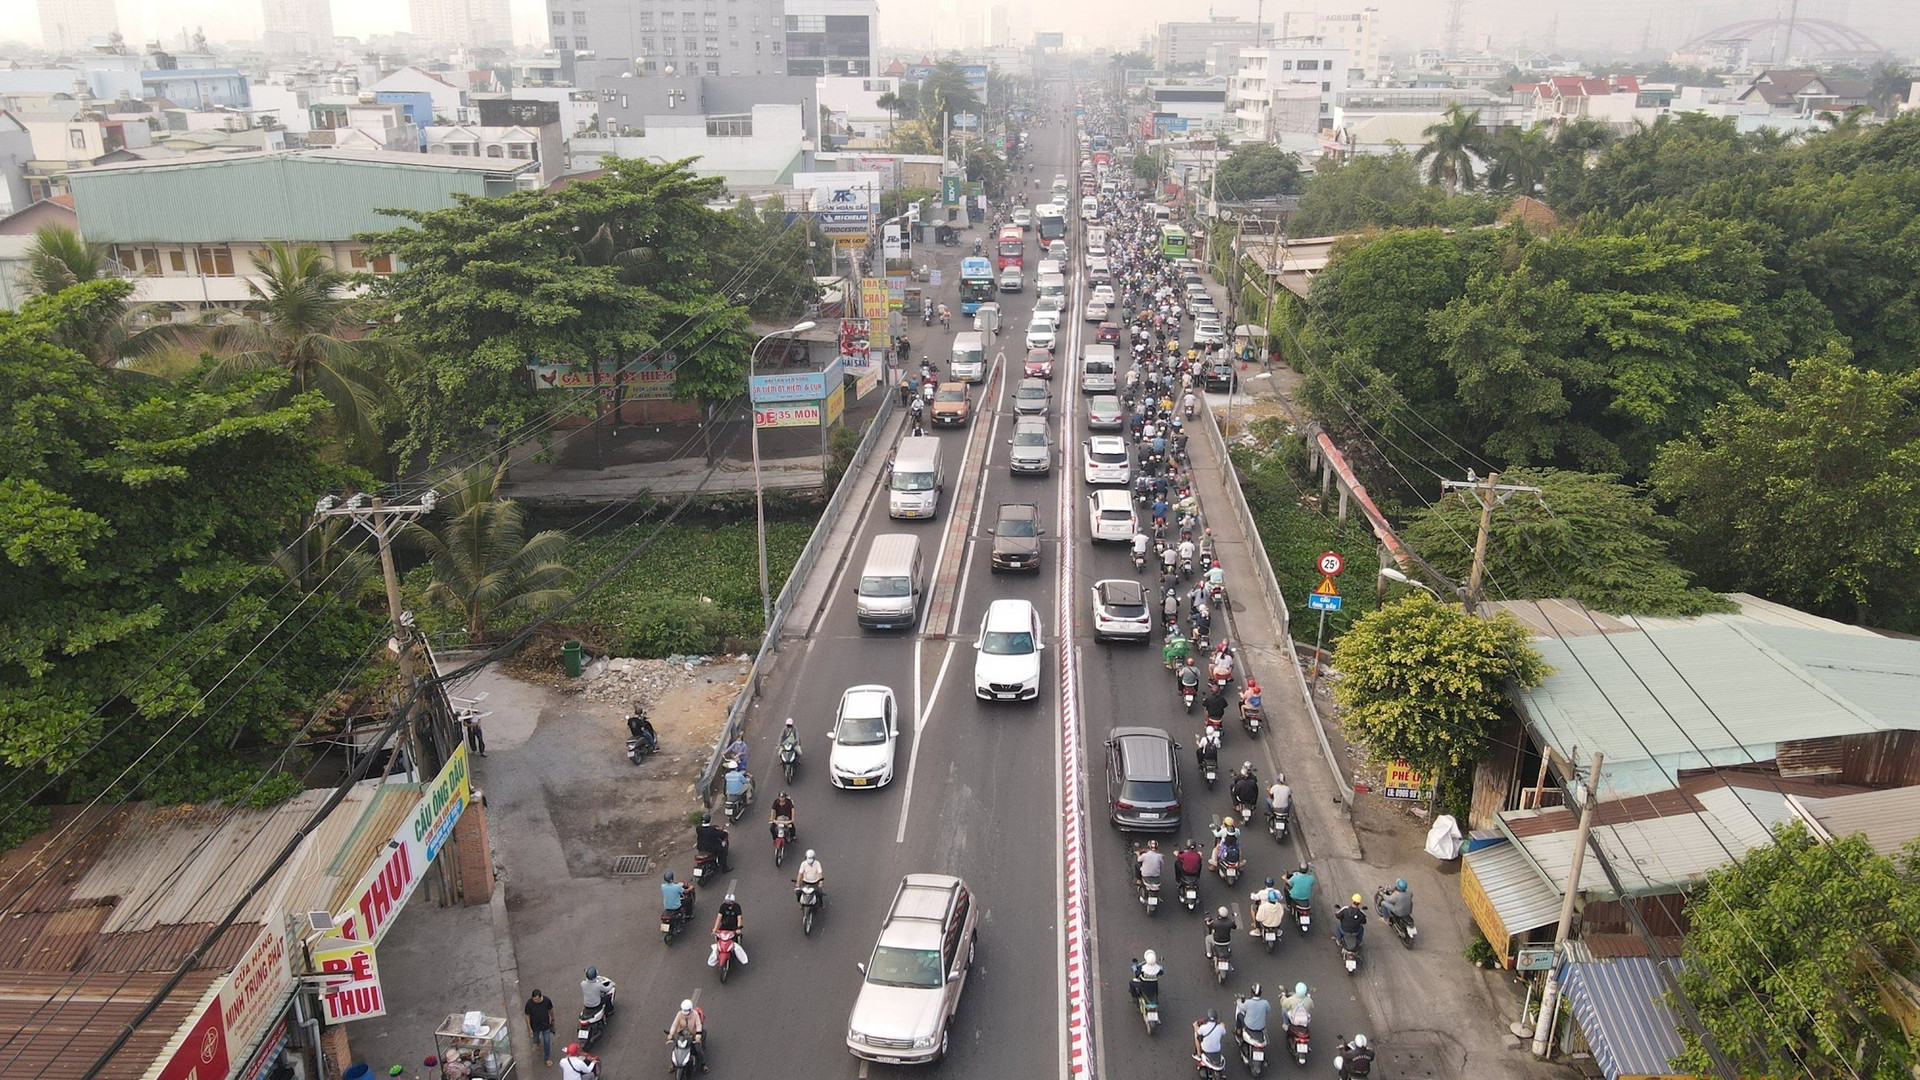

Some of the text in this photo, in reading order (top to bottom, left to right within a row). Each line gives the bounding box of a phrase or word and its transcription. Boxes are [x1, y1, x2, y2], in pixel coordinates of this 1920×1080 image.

[833, 213, 868, 221] MICHELIN
[778, 410, 791, 419] 35
[414, 803, 432, 842] CẦU
[432, 780, 449, 817] ÔNG
[359, 841, 412, 940] THUI
[225, 991, 246, 1031] MINH
[245, 961, 268, 1002] TRUNG
[267, 936, 285, 973] PHÁT
[234, 933, 273, 990] CỬA HÀNG
[322, 950, 374, 986] BÊ
[325, 986, 382, 1019] THUI
